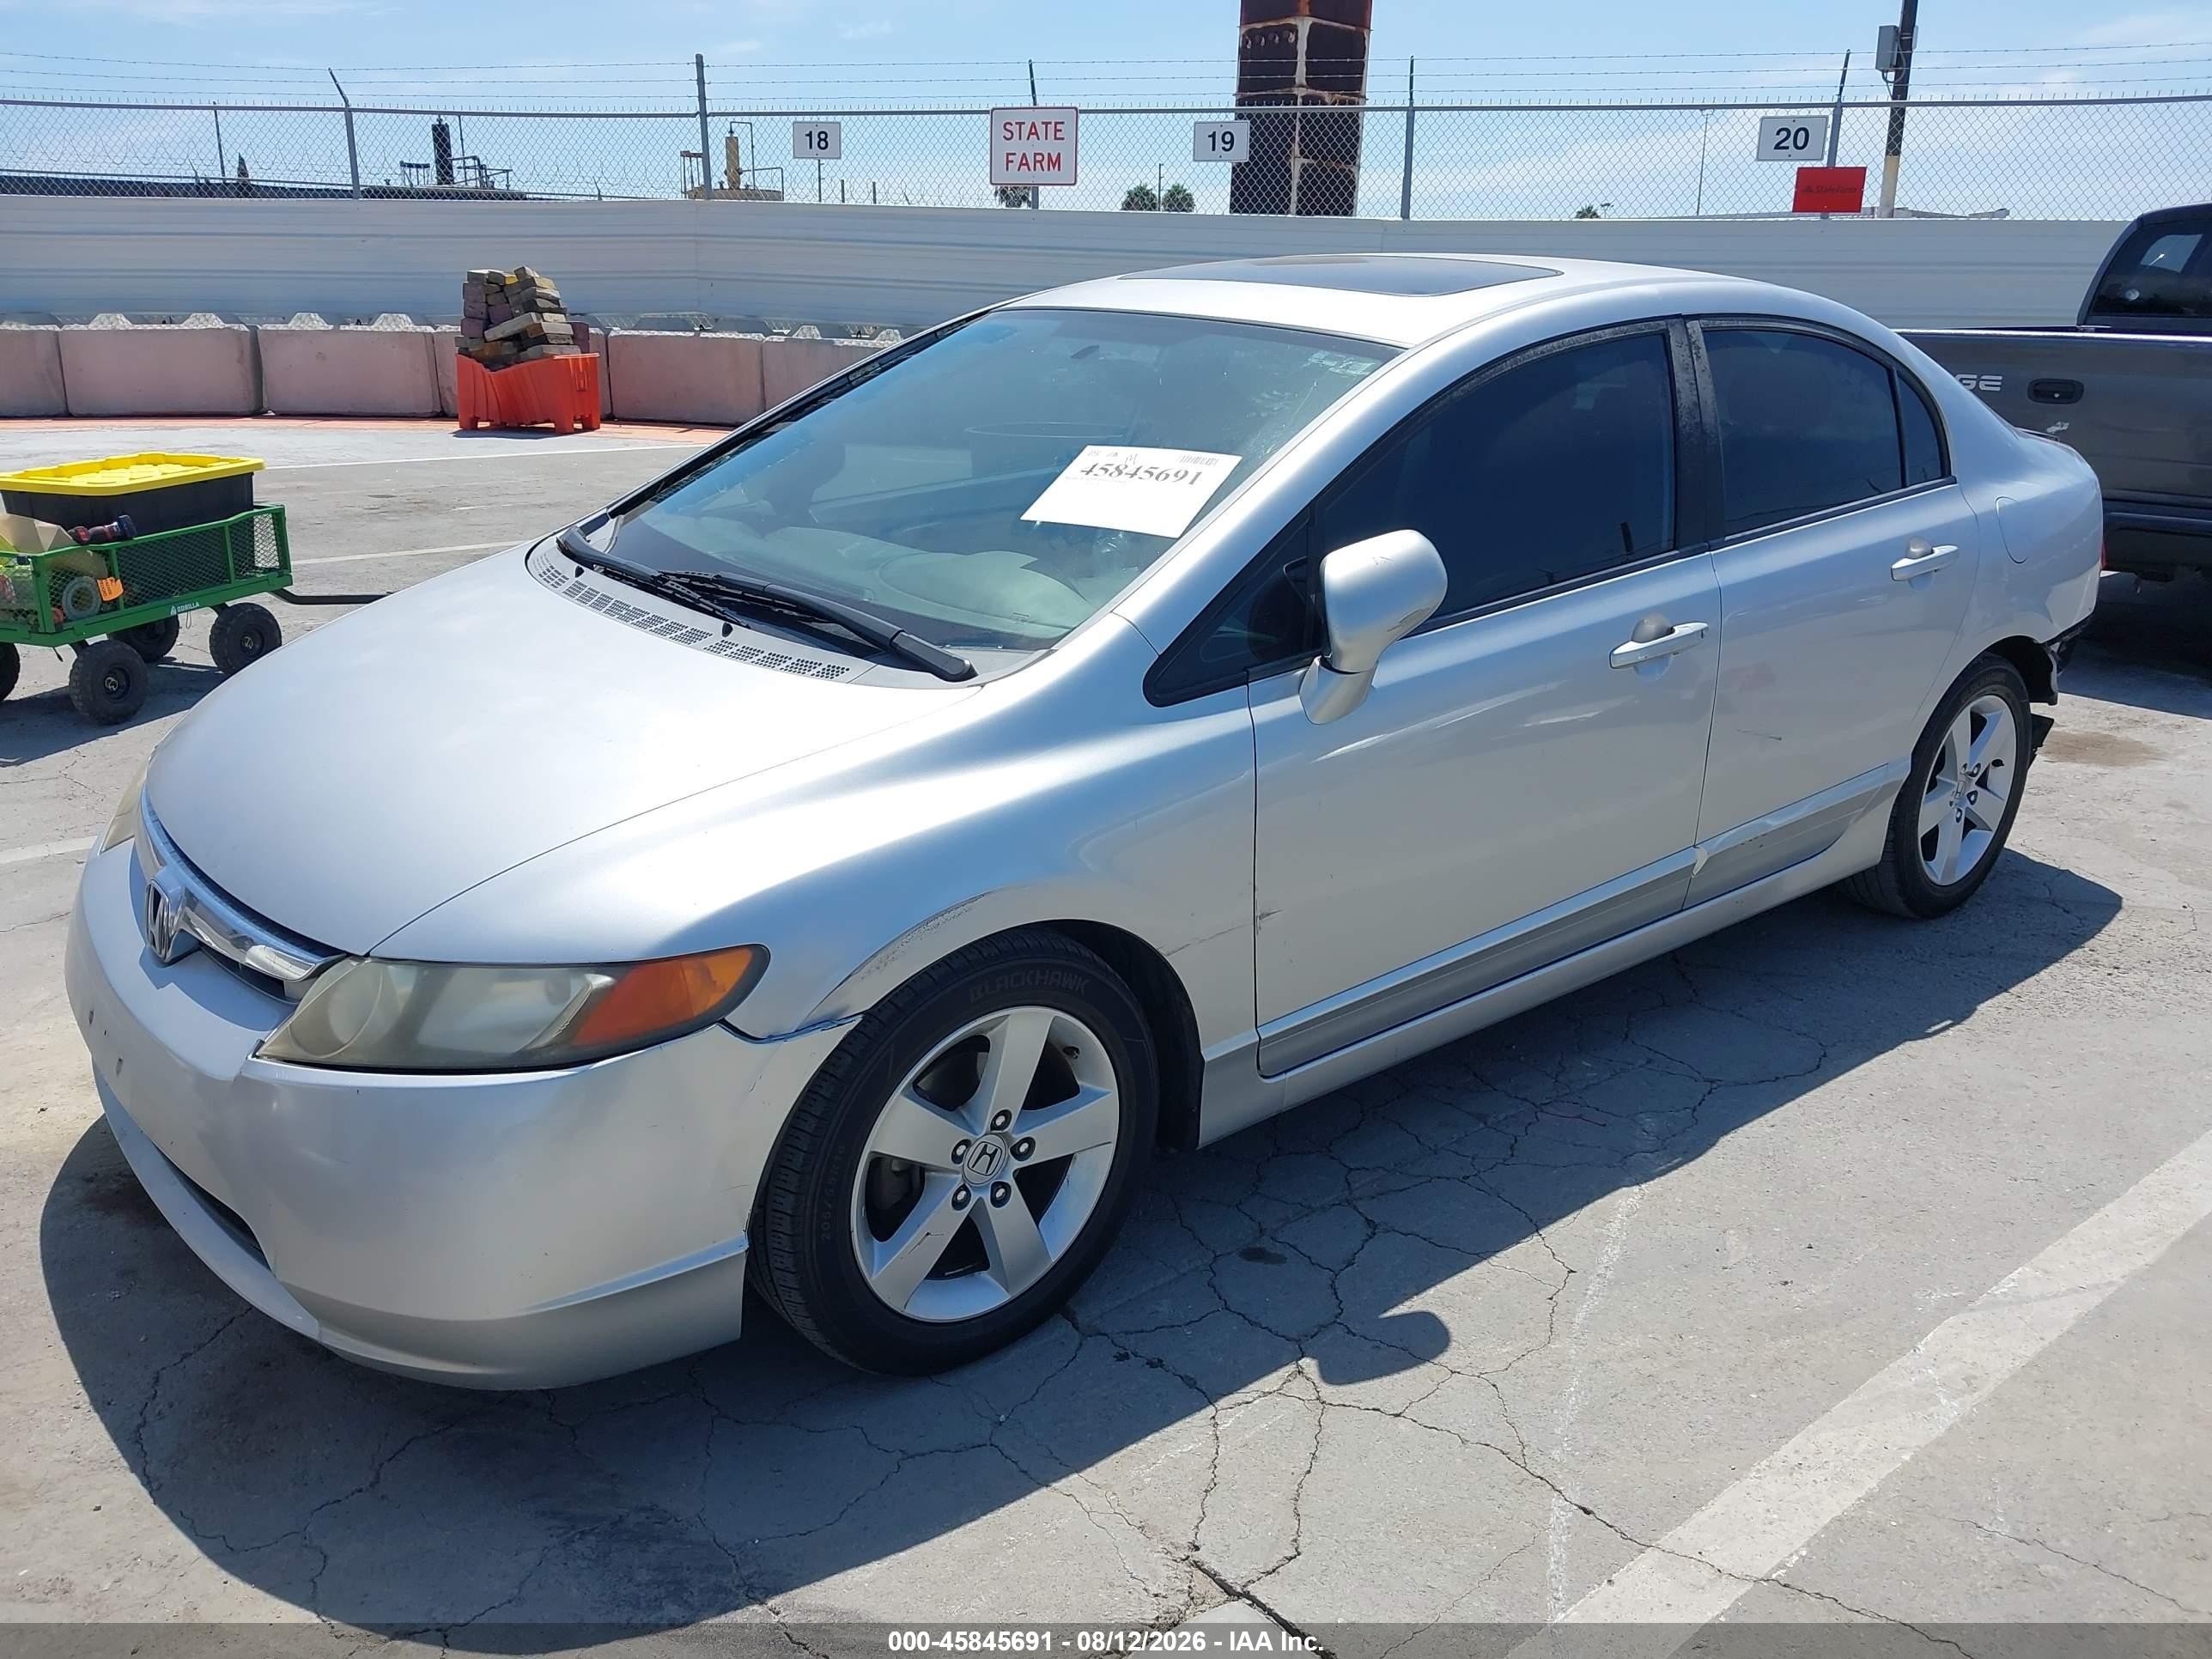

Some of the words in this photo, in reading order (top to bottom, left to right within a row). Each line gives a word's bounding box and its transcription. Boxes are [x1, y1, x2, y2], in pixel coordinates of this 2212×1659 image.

[804, 130, 830, 150] 18
[1002, 121, 1066, 141] STATE
[1207, 131, 1235, 152] 19
[1773, 127, 1810, 150] 20
[1005, 152, 1062, 173] FARM
[1080, 462, 1202, 485] 45845691
[969, 969, 1090, 1004] BLACKHAWK
